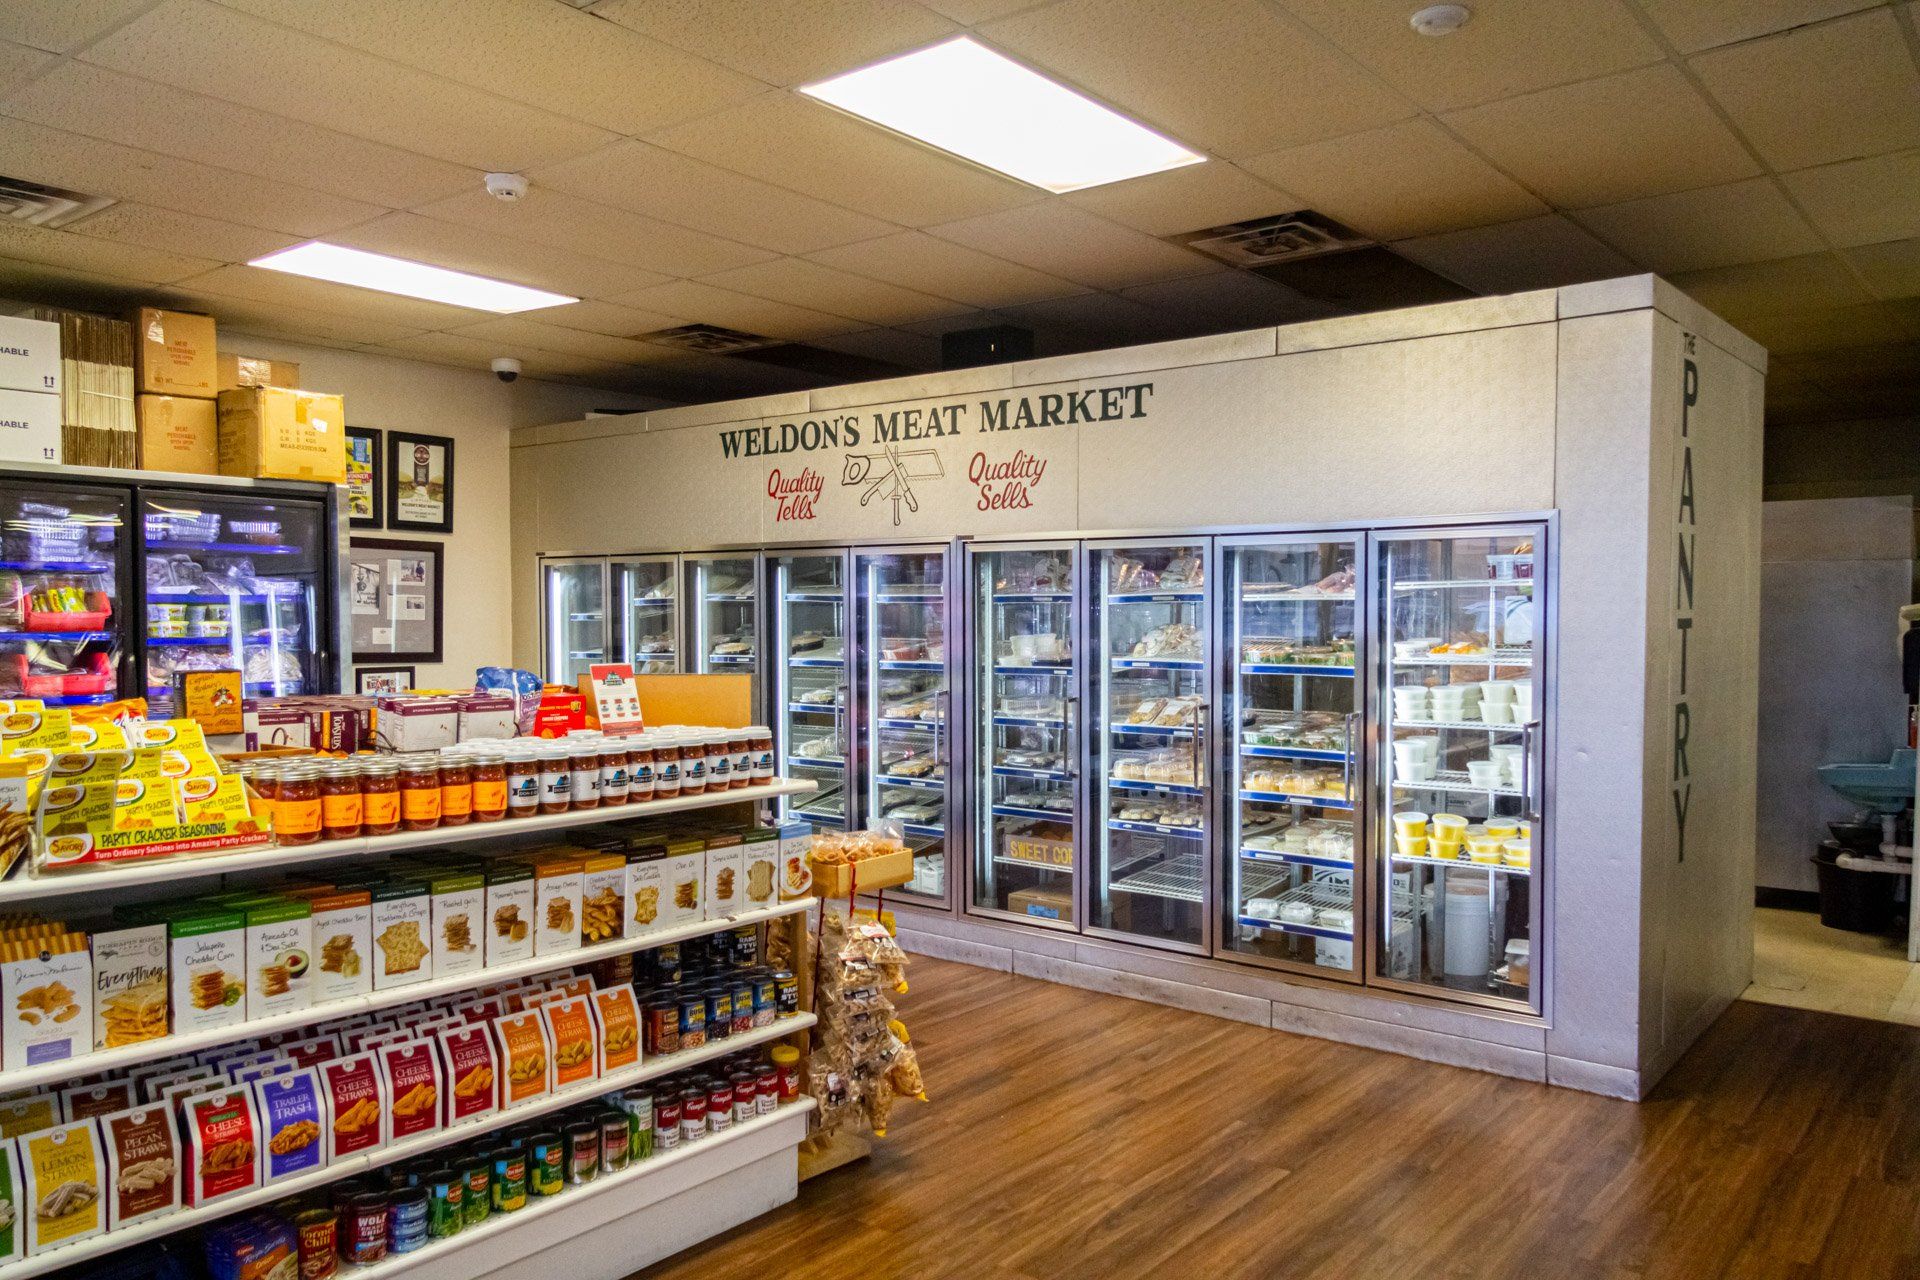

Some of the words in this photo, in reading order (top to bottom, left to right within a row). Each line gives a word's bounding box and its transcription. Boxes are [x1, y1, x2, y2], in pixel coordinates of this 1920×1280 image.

[719, 415, 861, 459] WELDON'S
[872, 404, 967, 444] MEAT
[979, 383, 1154, 433] MARKET
[968, 449, 1048, 487] Quality
[768, 467, 825, 504] Quality
[977, 482, 1034, 512] Sells
[776, 495, 817, 522] Tells
[1673, 357, 1698, 864] PANTRY
[101, 832, 131, 848] PARTY
[134, 828, 177, 844] CRACKER
[179, 822, 227, 839] SEASONING
[52, 840, 85, 855] SAVORY
[94, 852, 112, 860] Turn
[112, 848, 149, 858] Ordinary
[146, 845, 175, 855] Saltines
[176, 842, 190, 850] into
[191, 839, 220, 849] Amazing
[220, 836, 240, 846] Party
[240, 833, 268, 843] Crackers
[1010, 841, 1049, 862] SWEET
[376, 891, 404, 899] STONEWALL
[386, 900, 418, 913] Everything
[97, 965, 167, 991] Everything
[455, 1047, 486, 1062] CHEESE
[512, 1041, 541, 1055] STRAWS
[395, 1064, 430, 1079] CHEESE
[457, 1055, 488, 1071] STRAWS
[336, 1077, 373, 1094] CHEESE
[397, 1073, 431, 1088] STRAWS
[273, 1093, 310, 1109] TRAILER
[338, 1087, 374, 1104] STRAWS
[274, 1101, 312, 1120] TRASH
[205, 1116, 246, 1135] CHEESE
[214, 1127, 240, 1141] STRAWS
[123, 1140, 167, 1161] STRAWS
[124, 1131, 163, 1151] PECAN
[41, 1151, 87, 1173] LEMON
[42, 1161, 89, 1183] STRAWS
[304, 1235, 331, 1248] Chili
